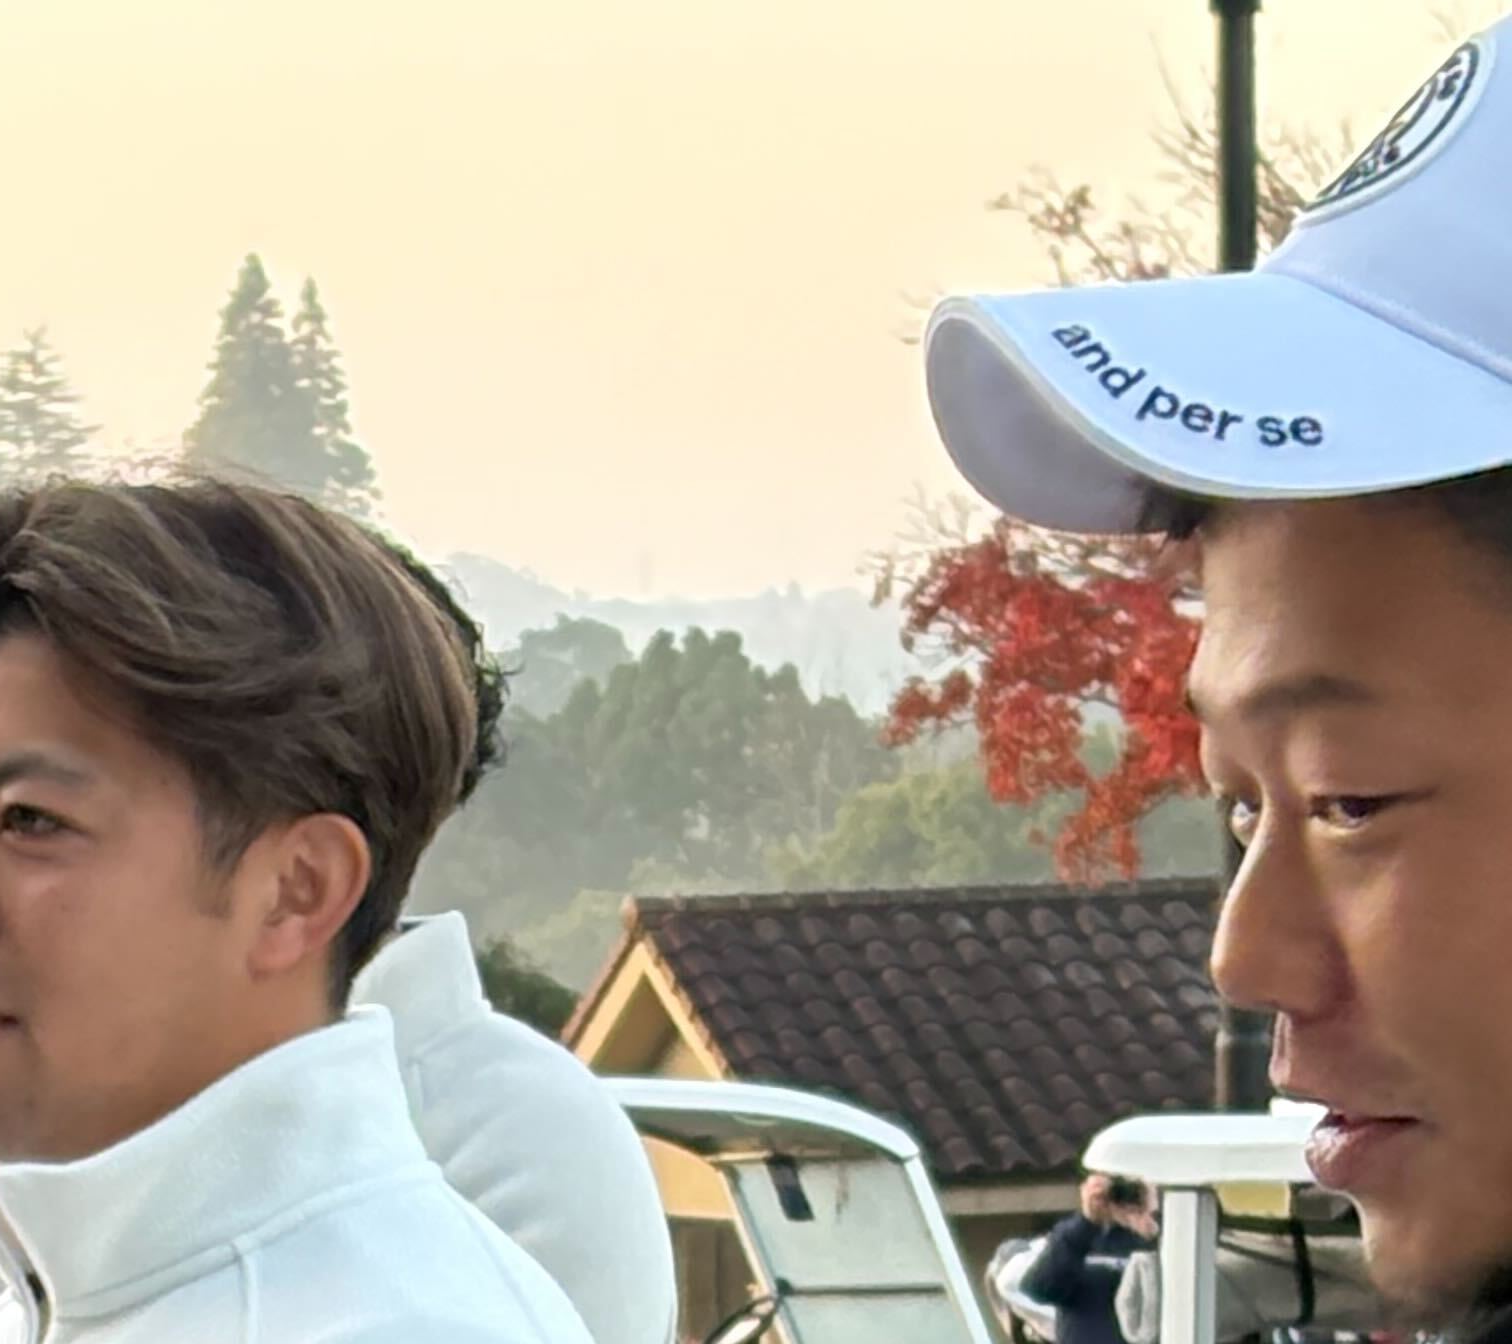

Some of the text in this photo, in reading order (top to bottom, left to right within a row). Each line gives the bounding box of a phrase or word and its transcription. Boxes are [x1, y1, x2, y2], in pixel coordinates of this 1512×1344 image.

[1052, 324, 1324, 447] and per se
